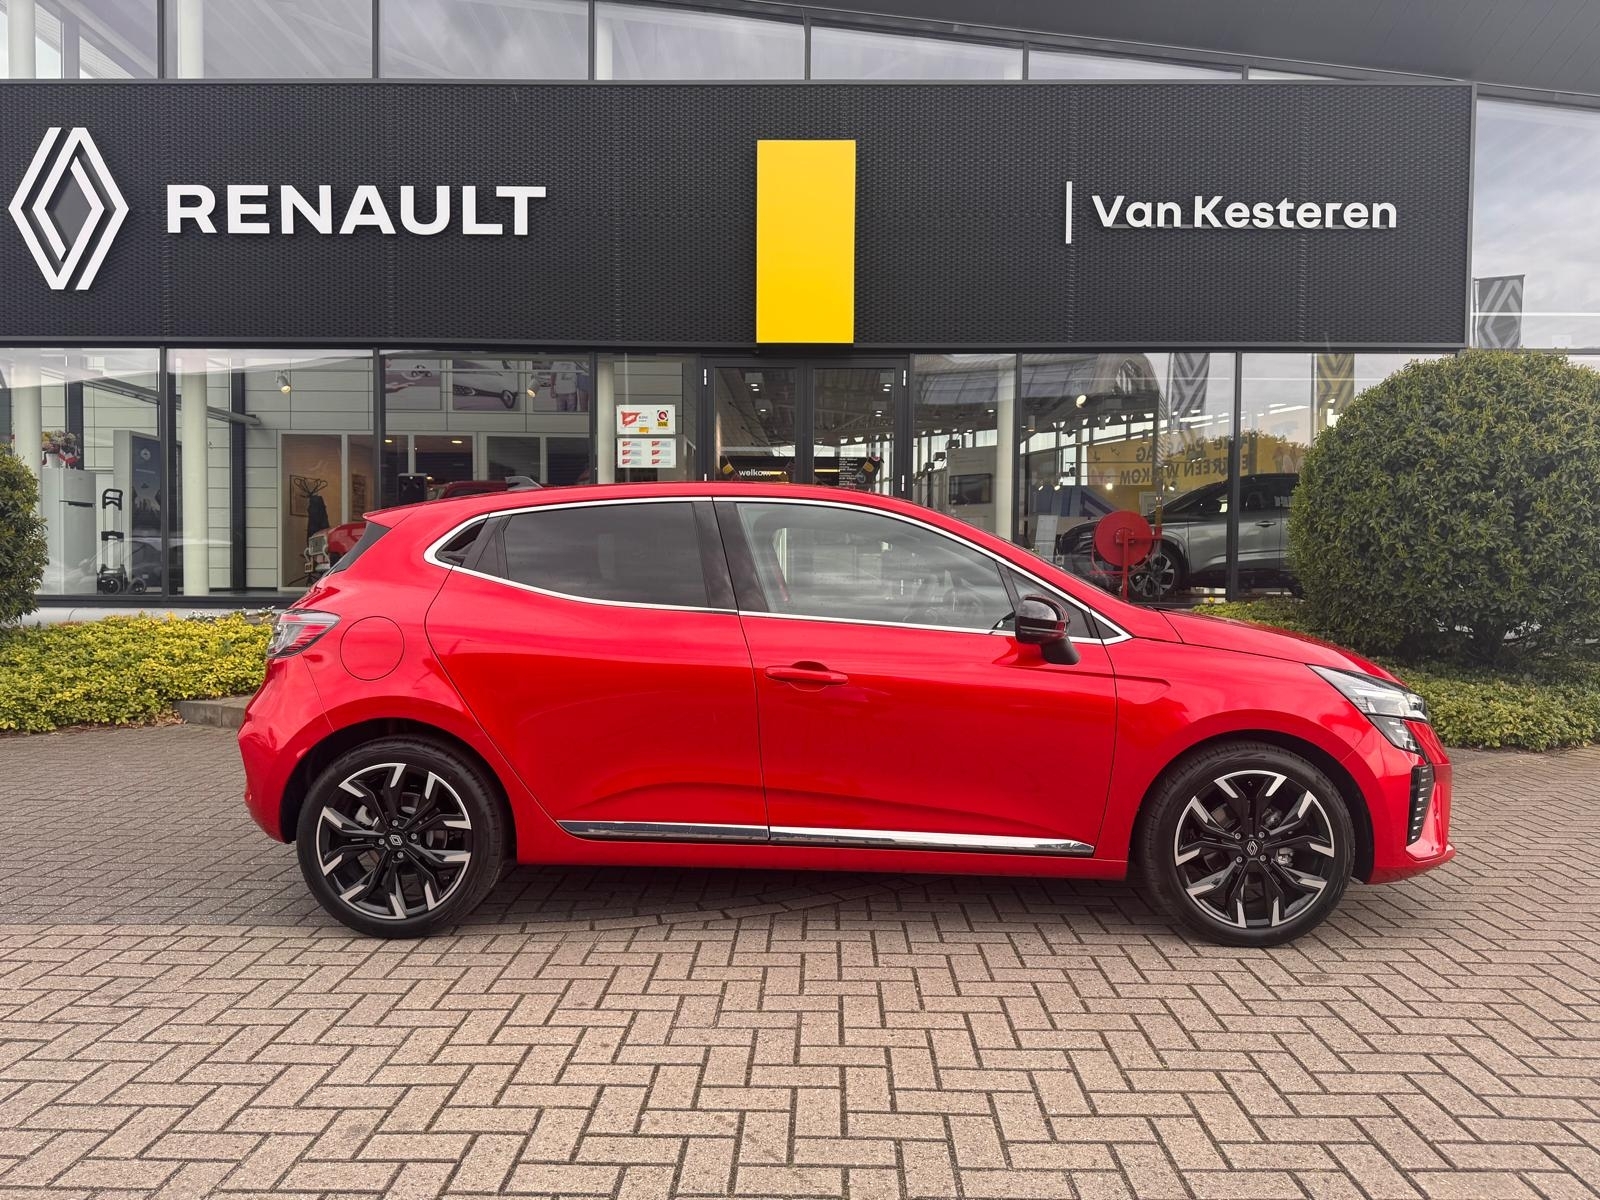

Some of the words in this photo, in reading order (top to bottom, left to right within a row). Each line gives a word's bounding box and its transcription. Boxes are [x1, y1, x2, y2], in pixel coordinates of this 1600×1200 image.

[166, 184, 547, 236] RENAULT
[1091, 195, 1182, 228] Van
[1193, 195, 1397, 229] Kesteren
